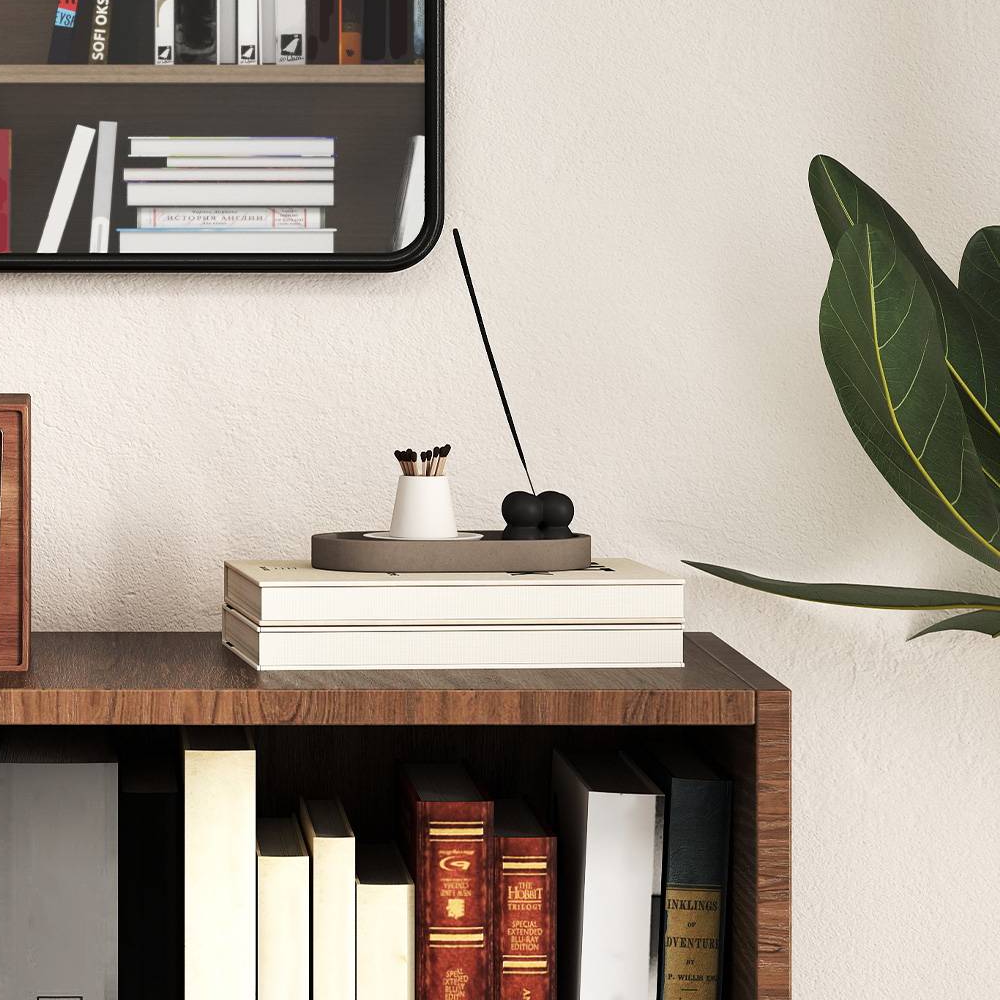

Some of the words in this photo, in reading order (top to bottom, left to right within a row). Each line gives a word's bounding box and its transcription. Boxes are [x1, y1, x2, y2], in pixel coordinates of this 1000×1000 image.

[91, 29, 106, 61] SOFI
[667, 899, 718, 912] INKLINGS
[511, 920, 538, 928] SPECIAL
[507, 928, 543, 936] EXTENDED
[510, 943, 540, 951] EDITION
